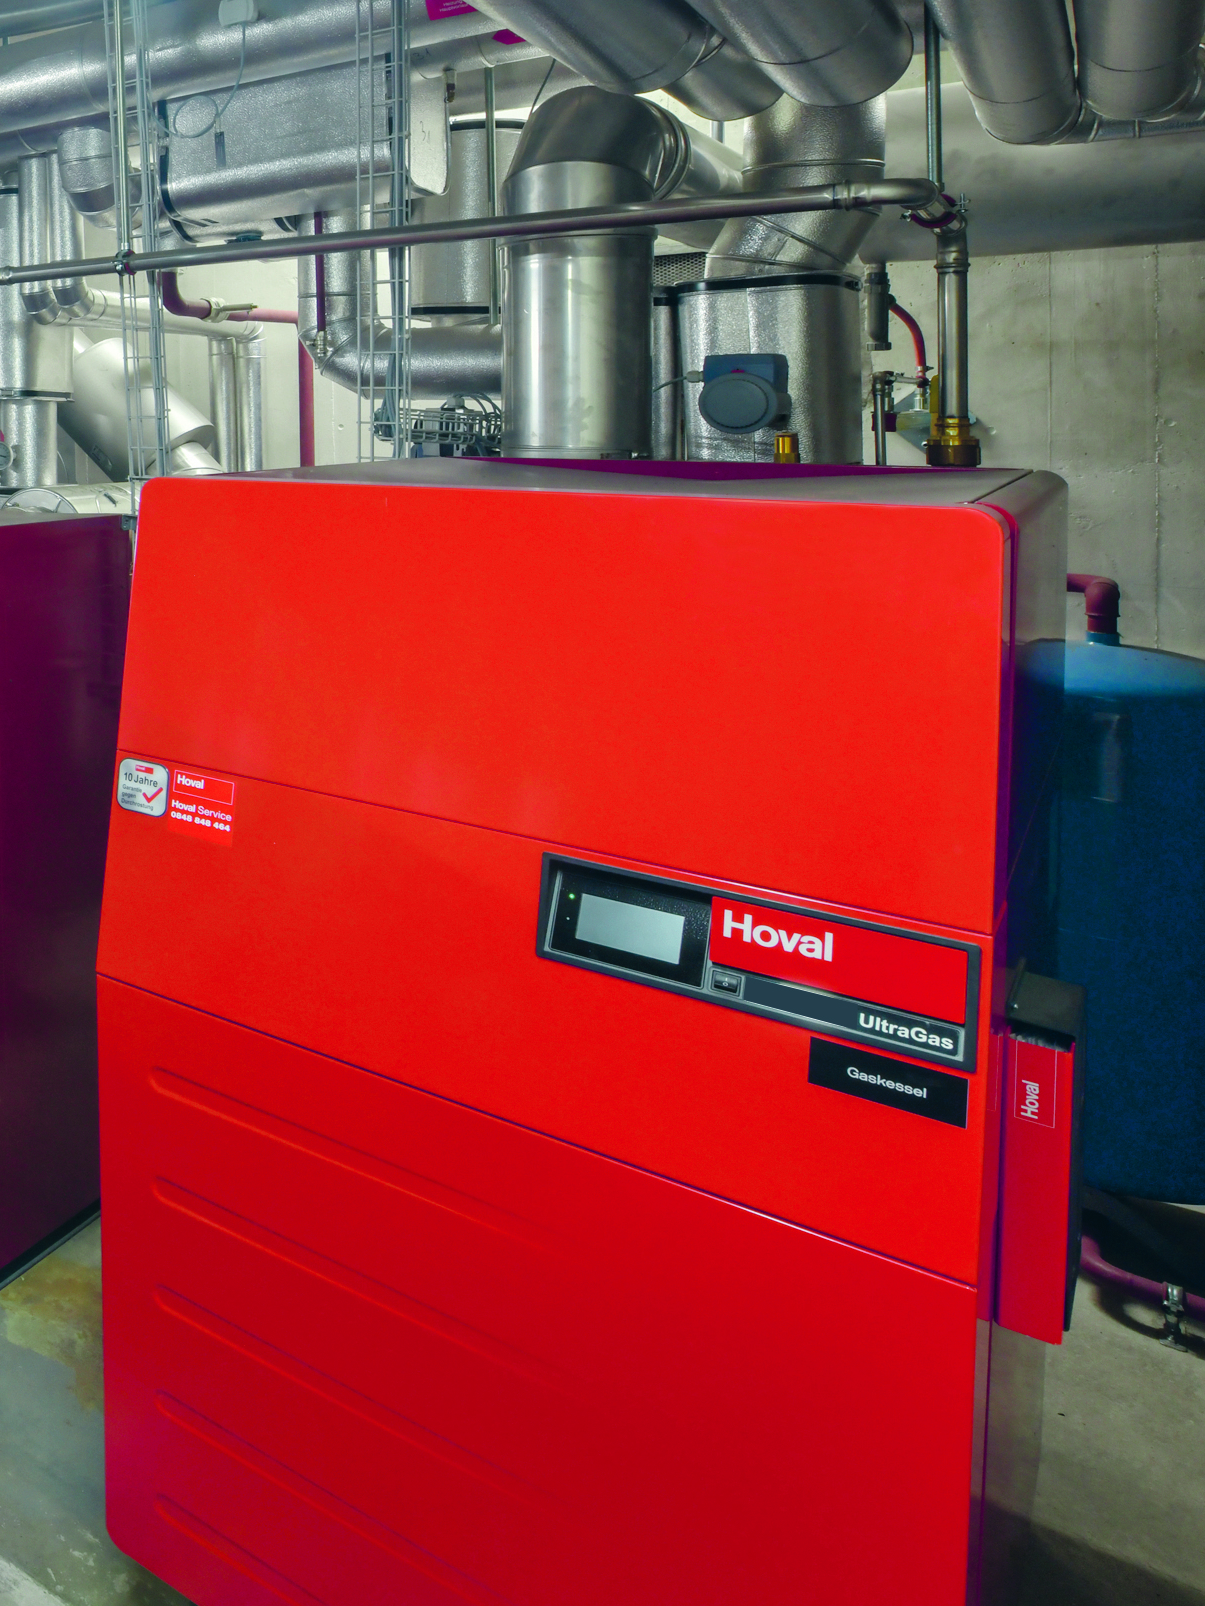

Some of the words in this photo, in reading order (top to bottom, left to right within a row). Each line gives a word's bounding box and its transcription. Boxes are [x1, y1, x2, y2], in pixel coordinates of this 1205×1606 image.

[122, 783, 143, 793] Garantie
[124, 772, 133, 782] 10
[134, 774, 158, 788] Jahre
[177, 774, 205, 789] Hoval
[121, 791, 137, 799] gegen
[121, 797, 154, 811] Durchrostung
[171, 799, 196, 813] Hoval
[197, 805, 232, 821] Service
[170, 811, 193, 823] 0848
[194, 816, 211, 827] 848
[213, 822, 231, 832] 464
[722, 909, 834, 962] Hoval
[858, 1012, 955, 1051] UltraGas
[846, 1066, 928, 1099] Gaskessel
[1020, 1079, 1040, 1119] Hoval
